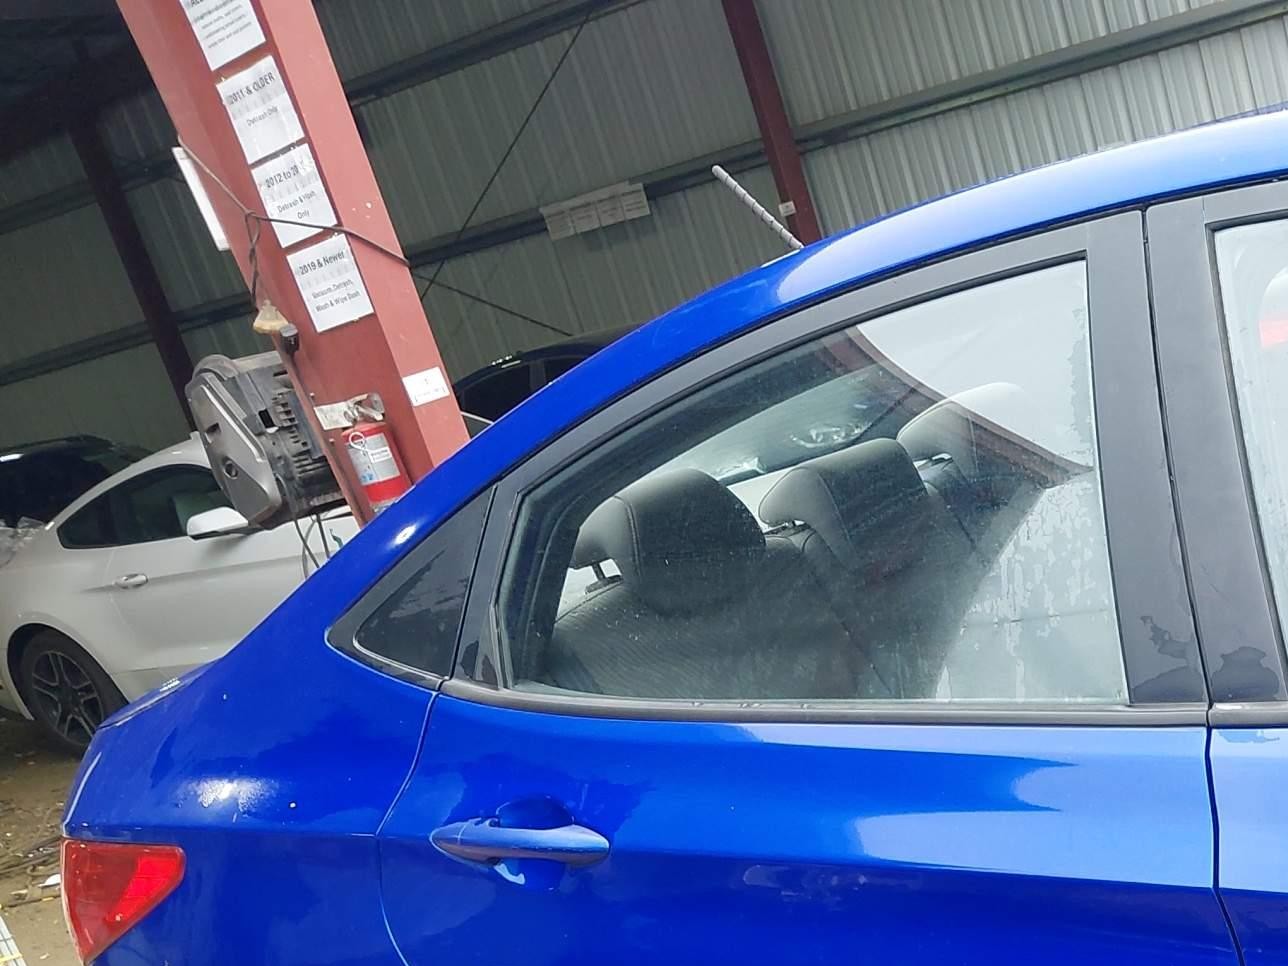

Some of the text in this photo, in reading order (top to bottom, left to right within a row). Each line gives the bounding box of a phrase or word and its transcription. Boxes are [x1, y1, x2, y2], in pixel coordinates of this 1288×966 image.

[253, 72, 275, 91] OLDER
[265, 173, 283, 188] 2012
[284, 171, 291, 179] to
[299, 262, 318, 275] 2019
[323, 251, 346, 265] Newer
